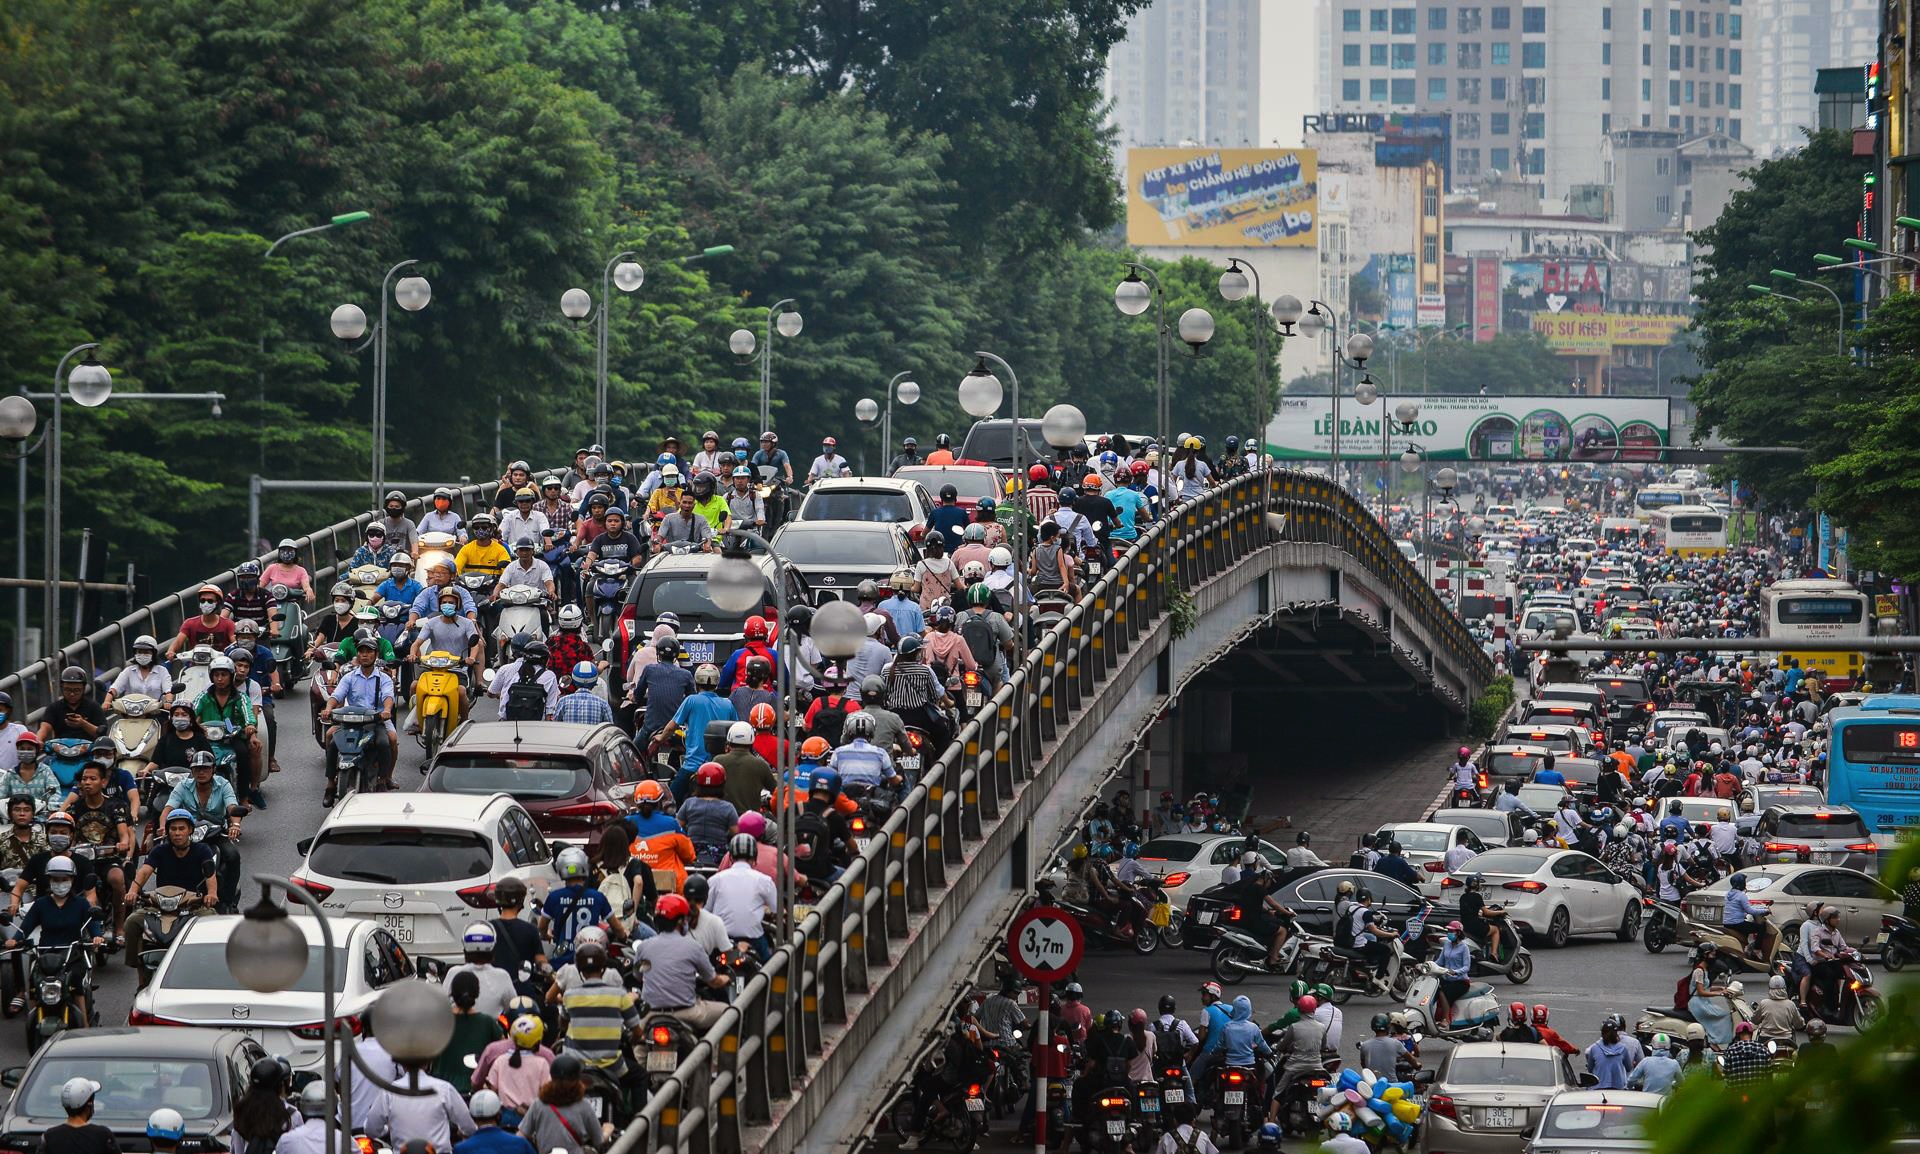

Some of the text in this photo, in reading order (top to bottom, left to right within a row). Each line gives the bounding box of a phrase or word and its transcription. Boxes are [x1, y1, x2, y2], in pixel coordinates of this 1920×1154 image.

[1340, 415, 1380, 436] BÀN
[690, 642, 707, 652] 80A
[1899, 732, 1917, 747] 18
[1877, 814, 1895, 824] 29B
[384, 915, 405, 928] 30E
[1024, 927, 1064, 959] 3,7m
[1492, 1108, 1508, 1117] 30E
[1486, 1118, 1513, 1127] 214.12
